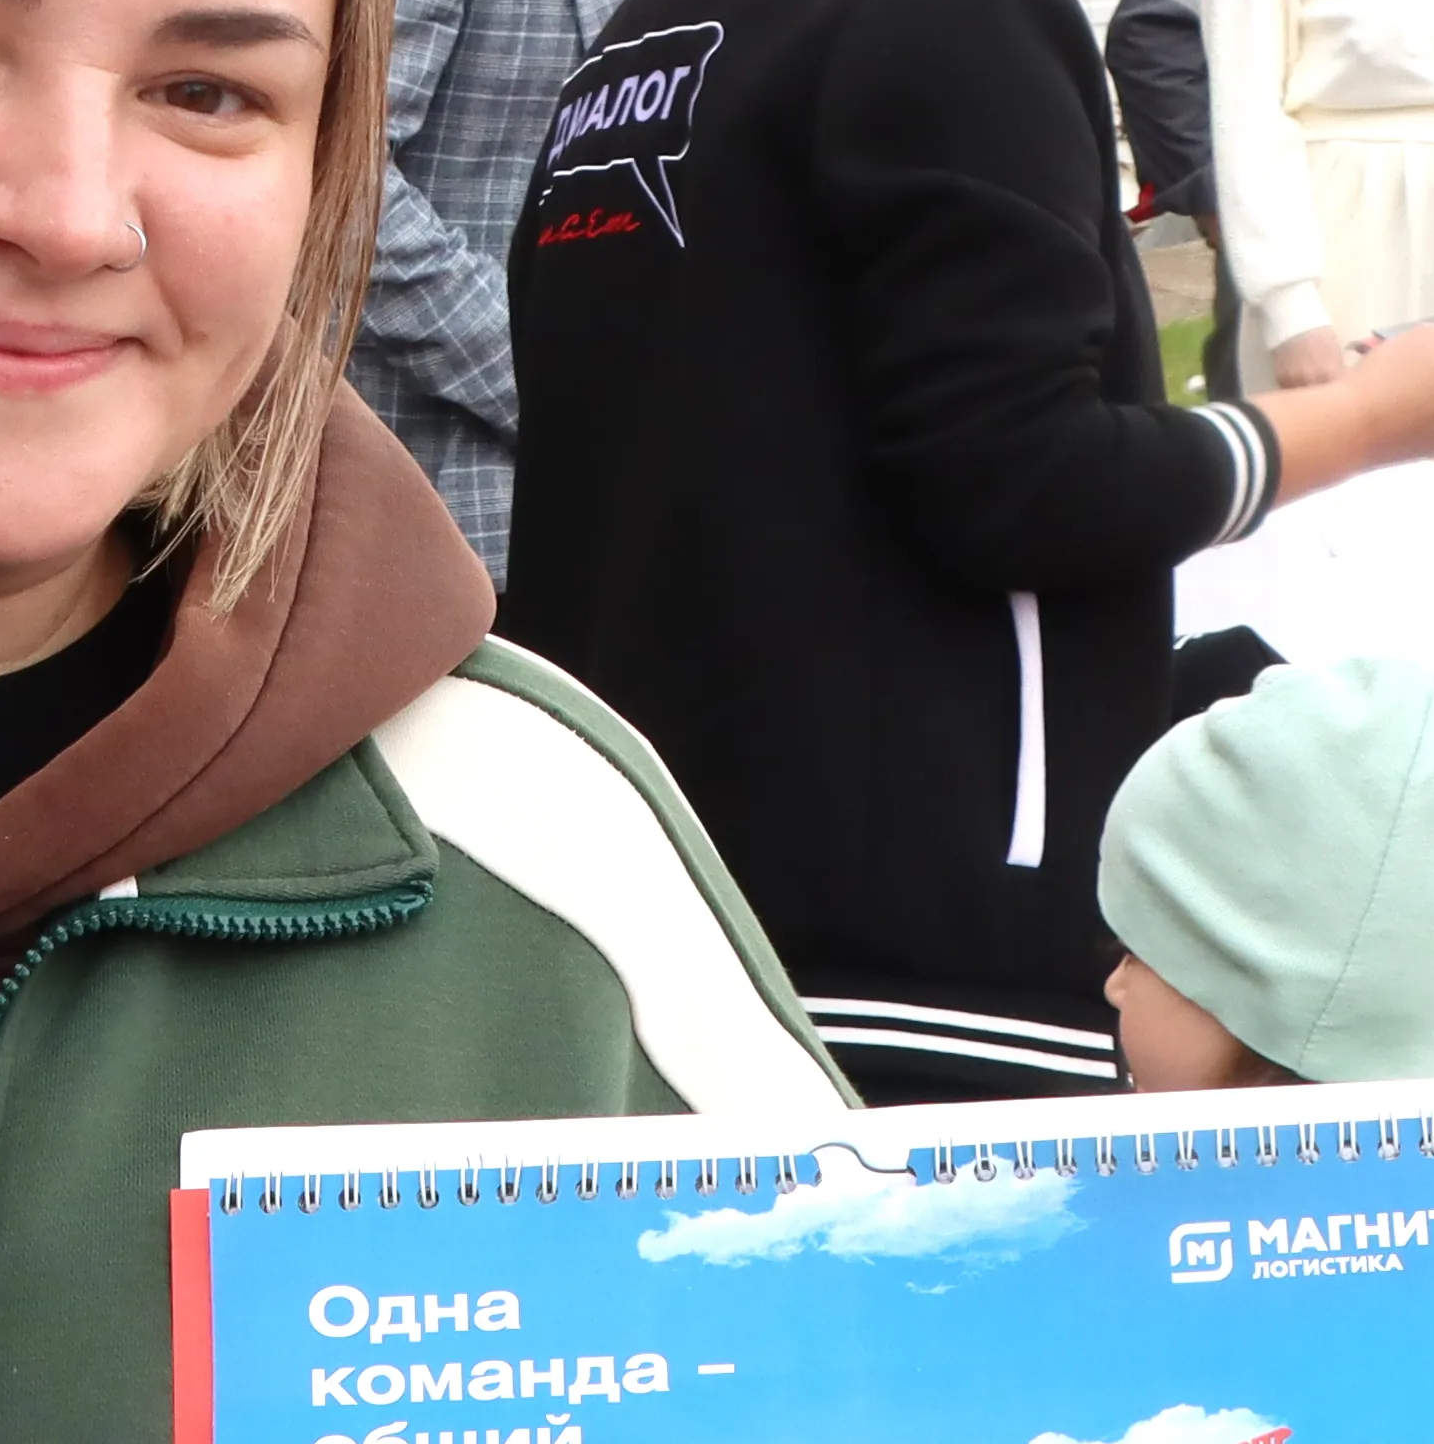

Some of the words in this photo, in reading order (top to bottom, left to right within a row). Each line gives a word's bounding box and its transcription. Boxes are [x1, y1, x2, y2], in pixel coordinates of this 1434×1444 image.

[547, 65, 692, 170] ДИАЛОГ
[1252, 1254, 1404, 1280] ЛОГИСТИКА
[308, 1285, 522, 1344] Одна
[311, 1353, 670, 1406] команда
